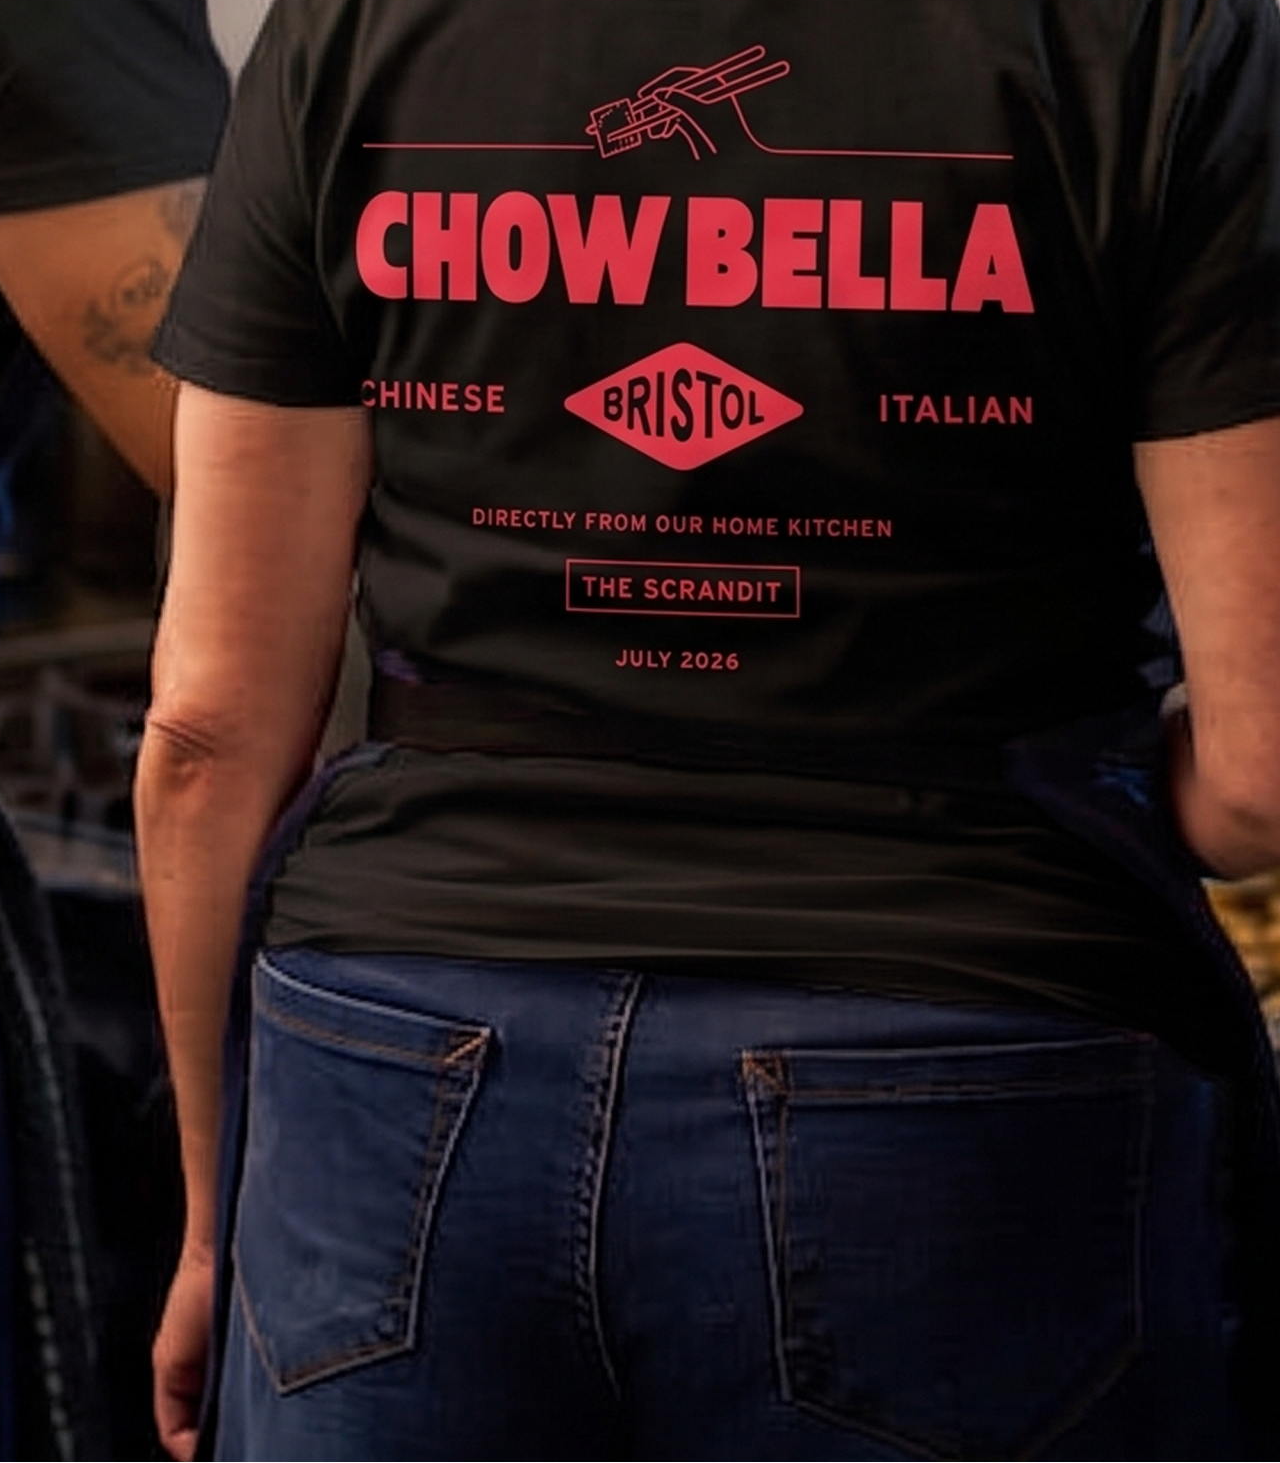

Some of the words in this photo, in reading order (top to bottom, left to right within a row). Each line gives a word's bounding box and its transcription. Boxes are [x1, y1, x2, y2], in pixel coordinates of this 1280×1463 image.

[354, 190, 672, 306] CHOW
[685, 195, 1035, 314] BELLA
[602, 365, 766, 444] BRISTOL
[880, 394, 1034, 425] ITALIAN
[472, 507, 577, 530] DIRECTLY
[584, 511, 648, 533] FROM
[655, 514, 704, 534] OUR
[712, 517, 779, 536] HOME
[788, 518, 893, 538] KITCHEN
[581, 575, 633, 600] THE
[642, 577, 783, 604] SCRANDIT
[615, 649, 671, 669] JULY
[680, 651, 740, 671] 2026
